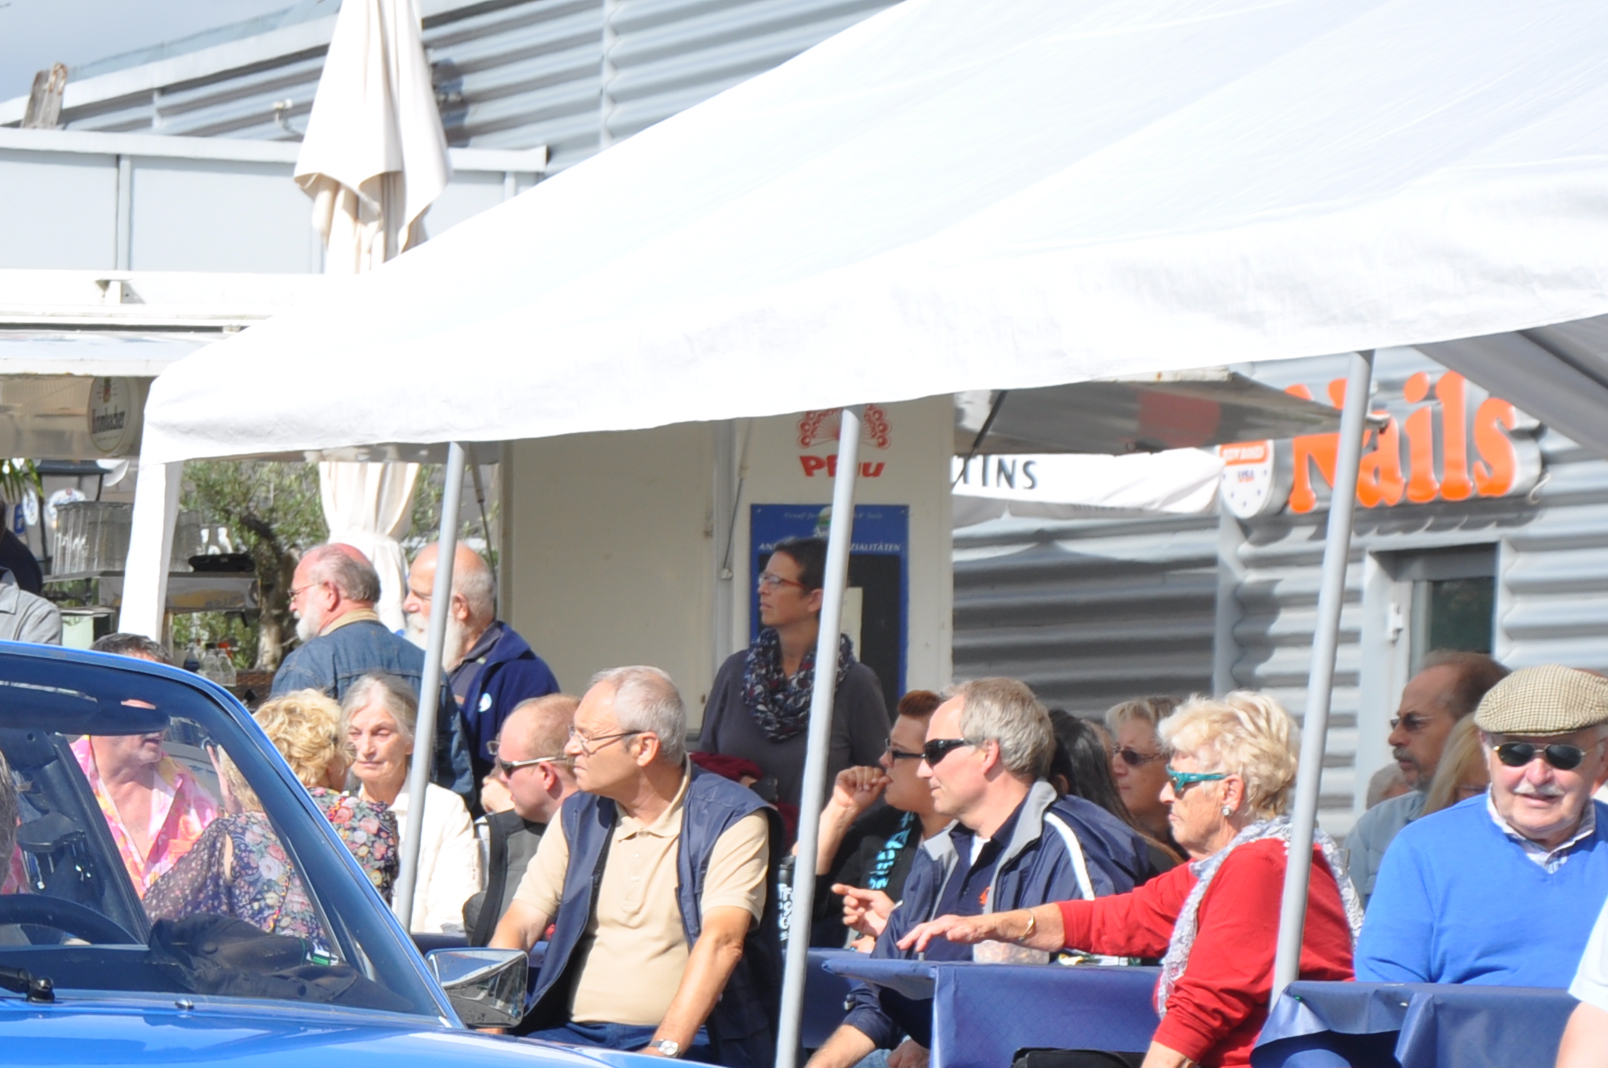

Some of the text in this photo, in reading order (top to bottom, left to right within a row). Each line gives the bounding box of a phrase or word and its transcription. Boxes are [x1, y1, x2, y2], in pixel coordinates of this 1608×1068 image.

[1285, 370, 1517, 513] Nails
[799, 454, 885, 487] Pfu
[954, 456, 1039, 490] TINS
[849, 542, 901, 552] ZIALITÄTEN
